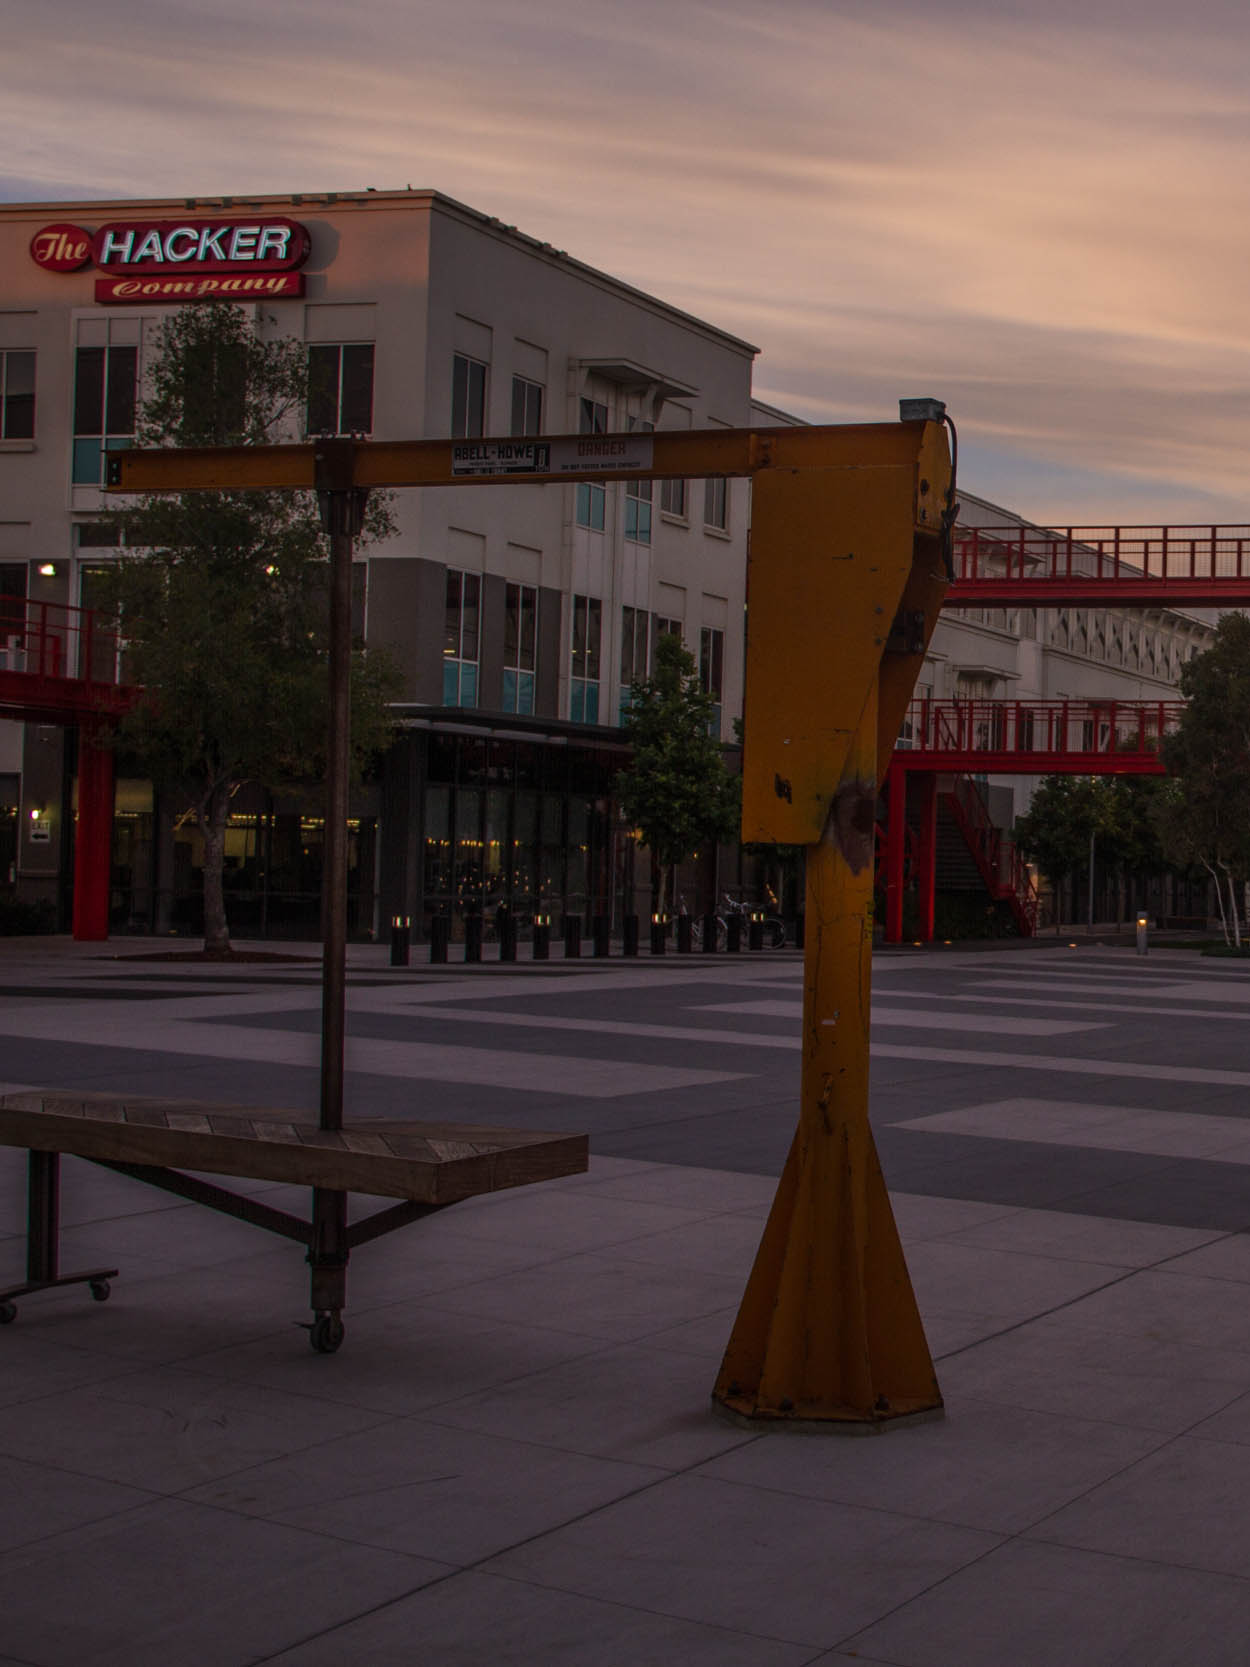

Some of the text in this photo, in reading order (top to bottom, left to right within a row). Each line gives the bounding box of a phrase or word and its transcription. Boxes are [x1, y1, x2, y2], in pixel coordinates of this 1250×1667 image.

[36, 224, 292, 264] The HACKER
[111, 277, 290, 297] Company
